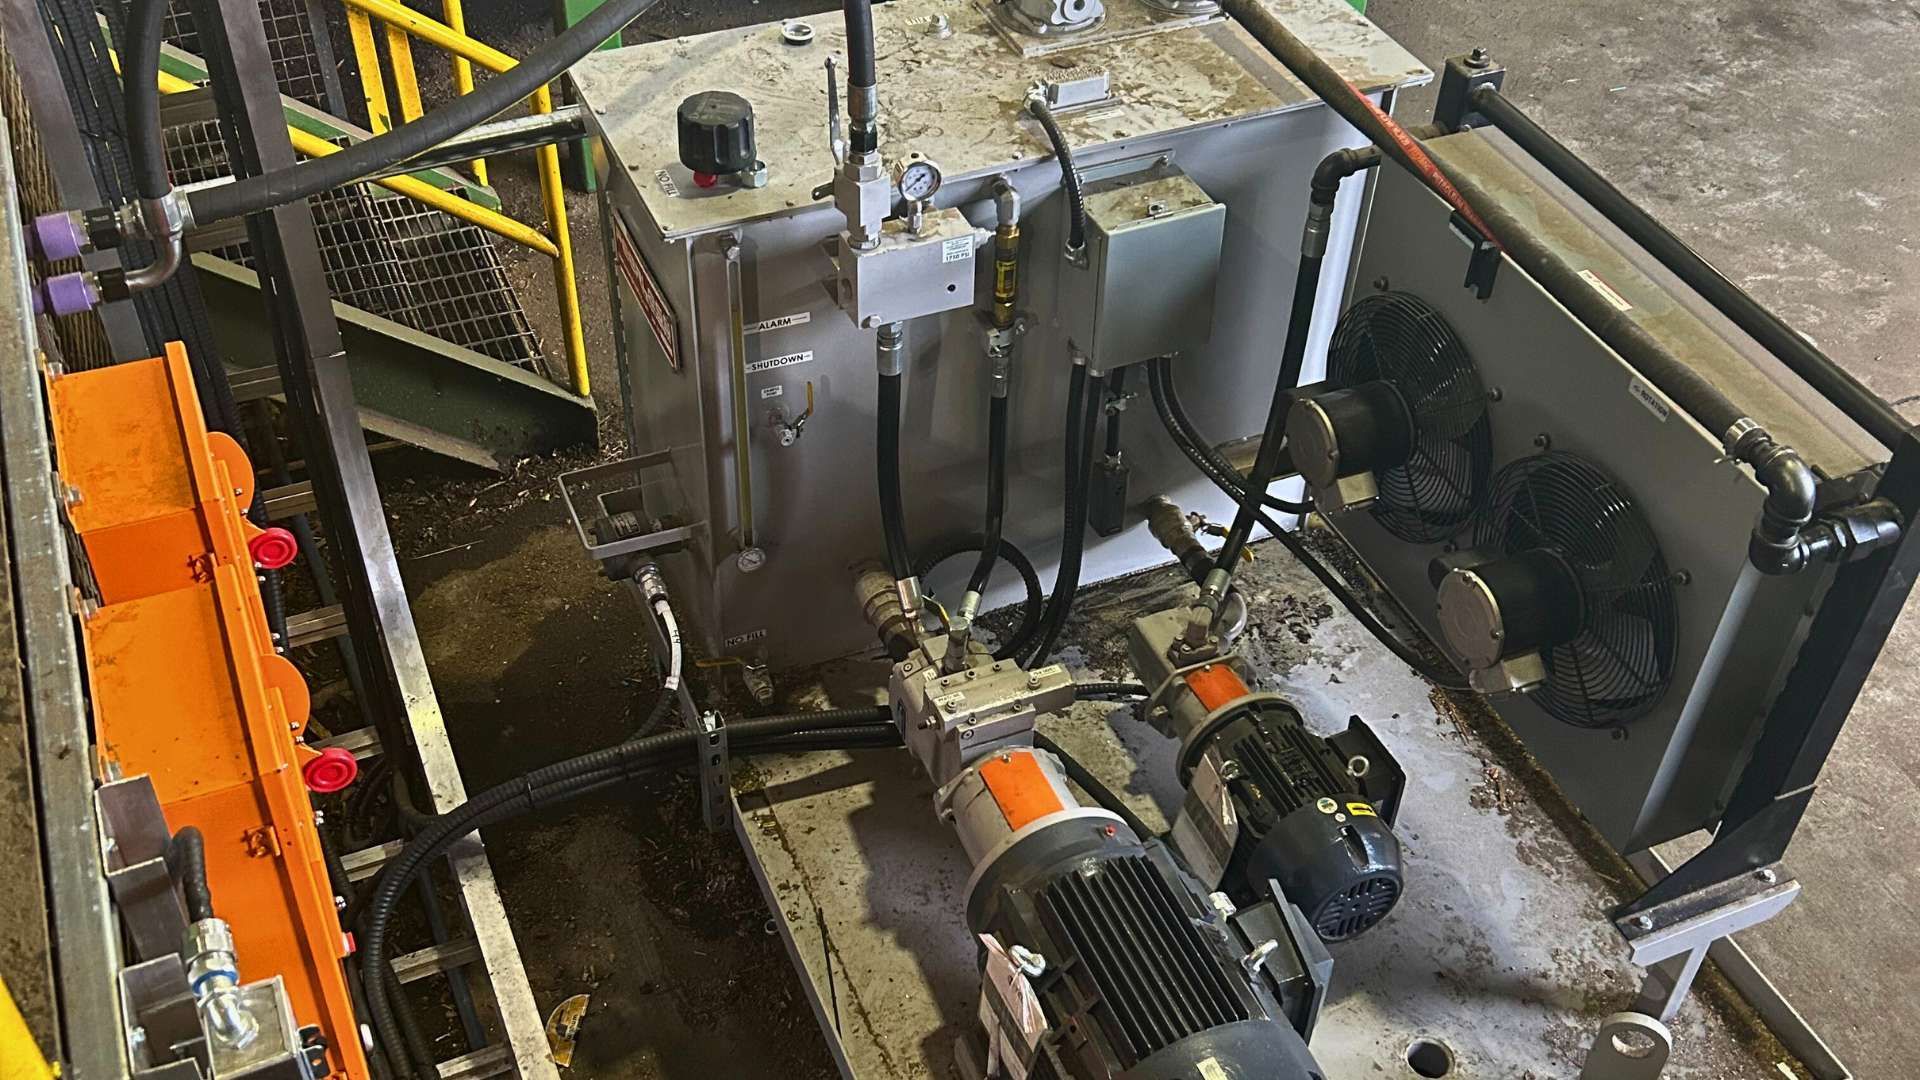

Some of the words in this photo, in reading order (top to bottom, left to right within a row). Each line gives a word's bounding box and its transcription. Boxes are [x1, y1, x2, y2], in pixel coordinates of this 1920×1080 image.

[658, 170, 670, 182] NO
[758, 317, 792, 331] ALARM
[751, 354, 804, 371] SHUTDOWN
[1640, 389, 1668, 418] ROTATION
[727, 636, 744, 647] NO
